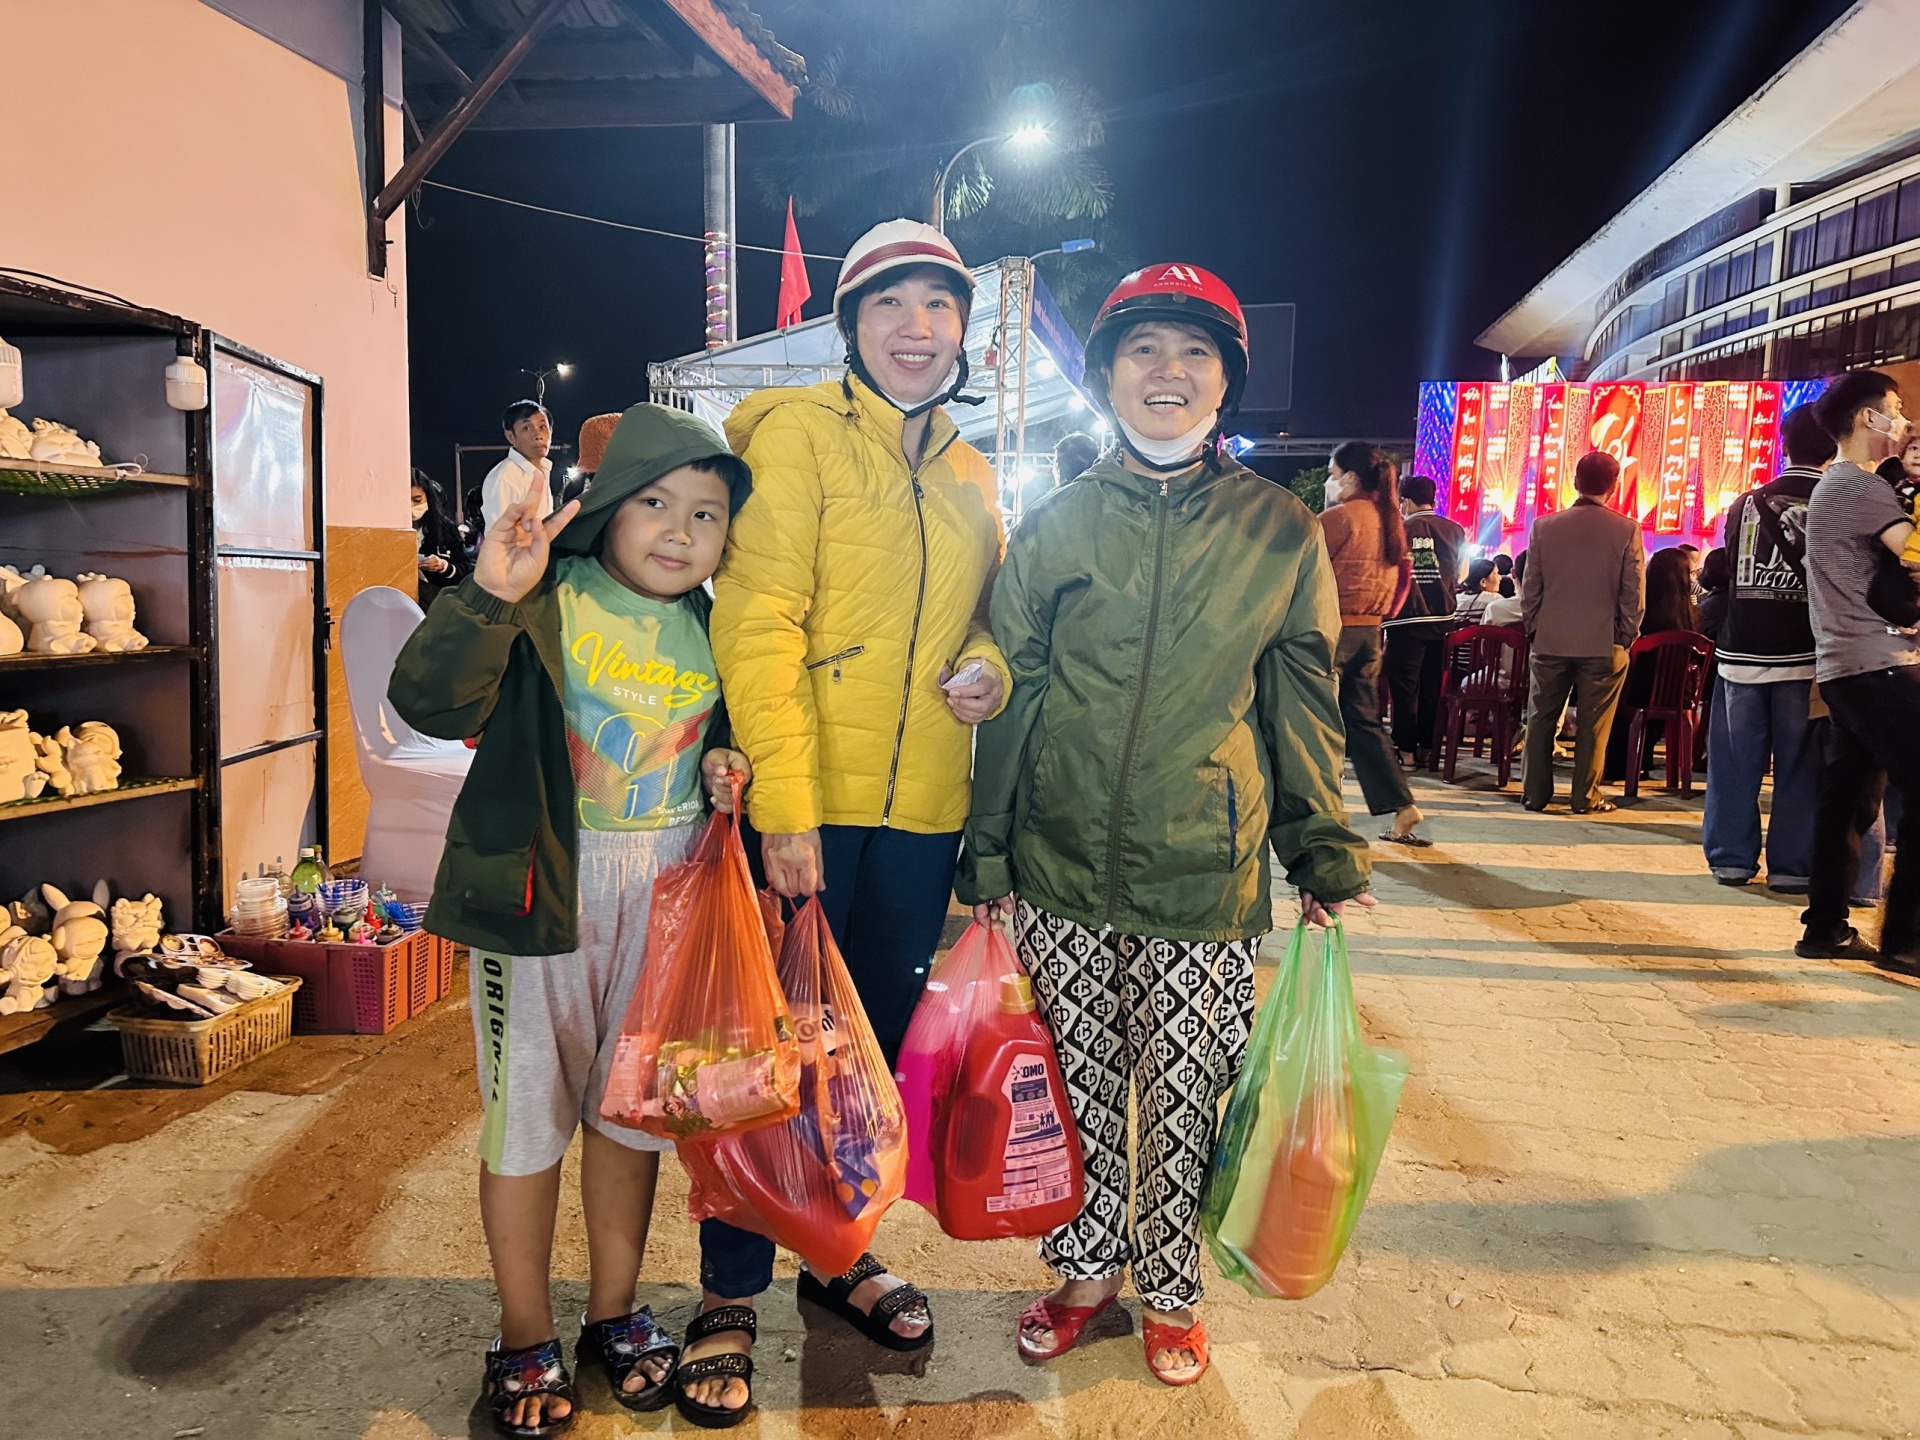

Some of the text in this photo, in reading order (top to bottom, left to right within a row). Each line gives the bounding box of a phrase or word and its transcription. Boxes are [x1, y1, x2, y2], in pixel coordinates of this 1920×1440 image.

[571, 631, 717, 709] Vintage
[613, 686, 657, 706] STYLE
[1022, 1063, 1045, 1079] OMO
